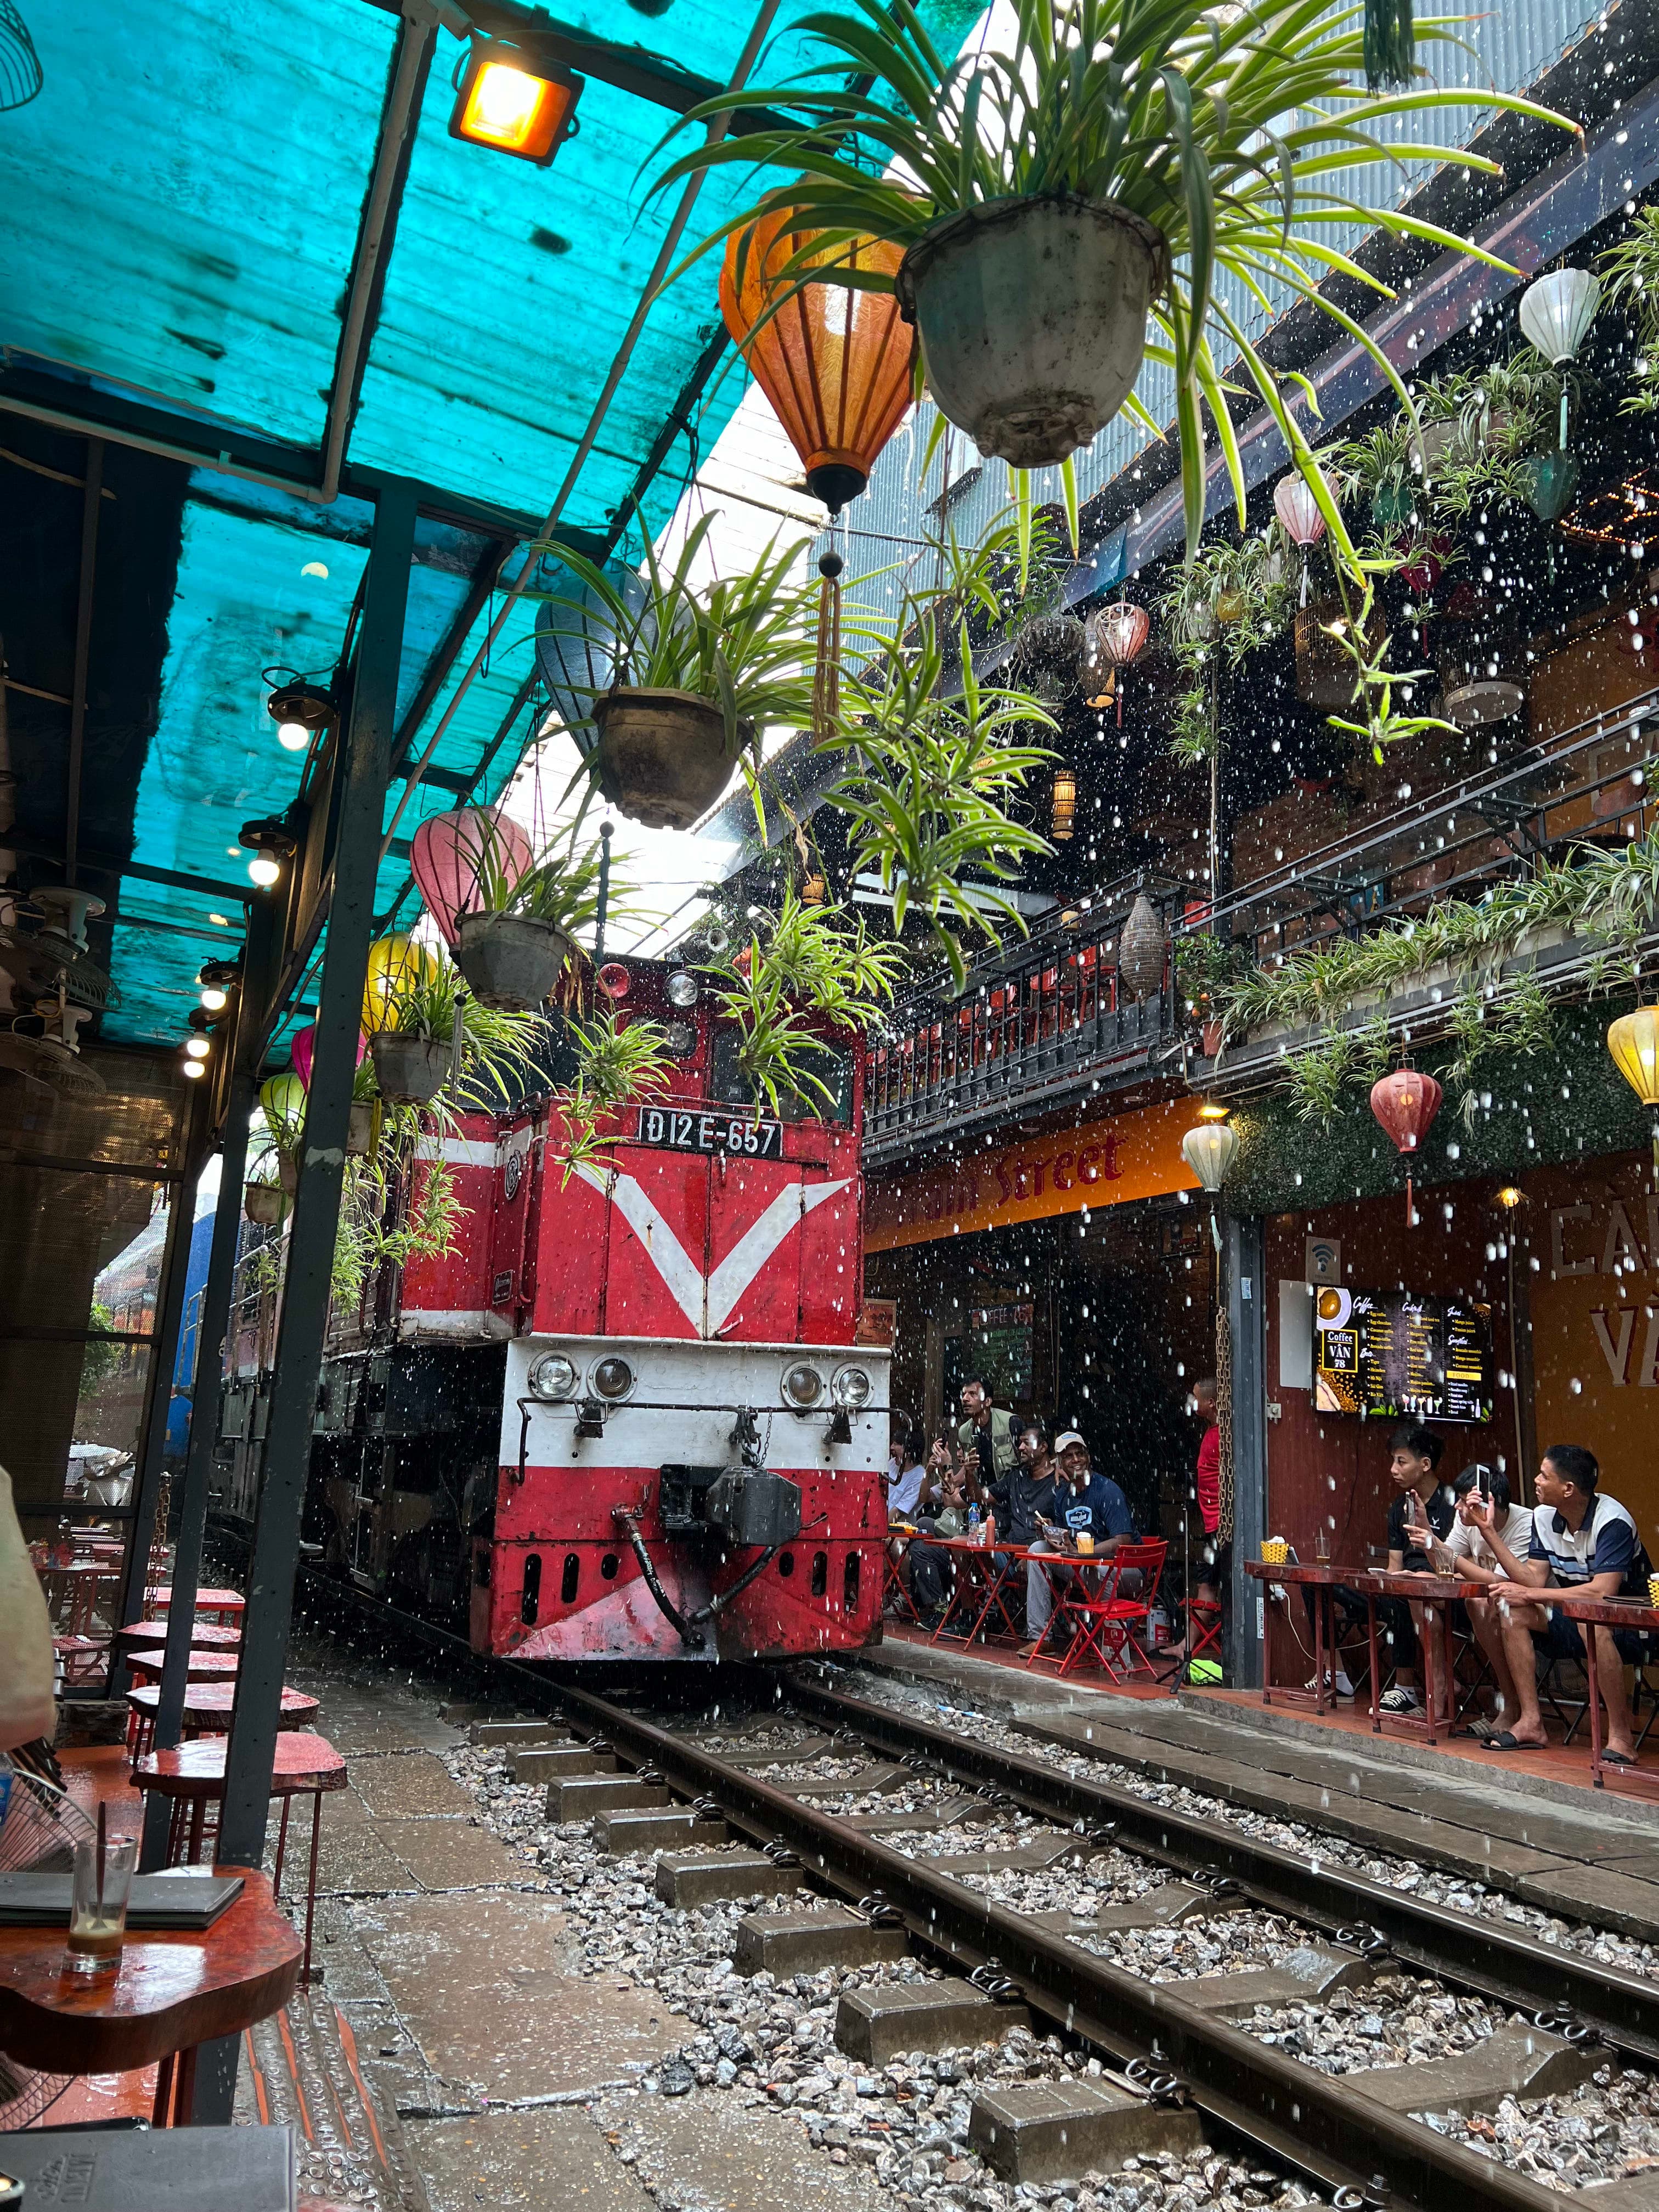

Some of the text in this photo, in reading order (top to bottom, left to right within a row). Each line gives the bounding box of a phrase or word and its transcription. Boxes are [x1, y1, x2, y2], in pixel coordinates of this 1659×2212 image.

[995, 1132, 1130, 1207] Street
[1328, 1331, 1353, 1342] Coffee
[1329, 1343, 1351, 1358] VÂN
[1334, 1359, 1346, 1368] 78
